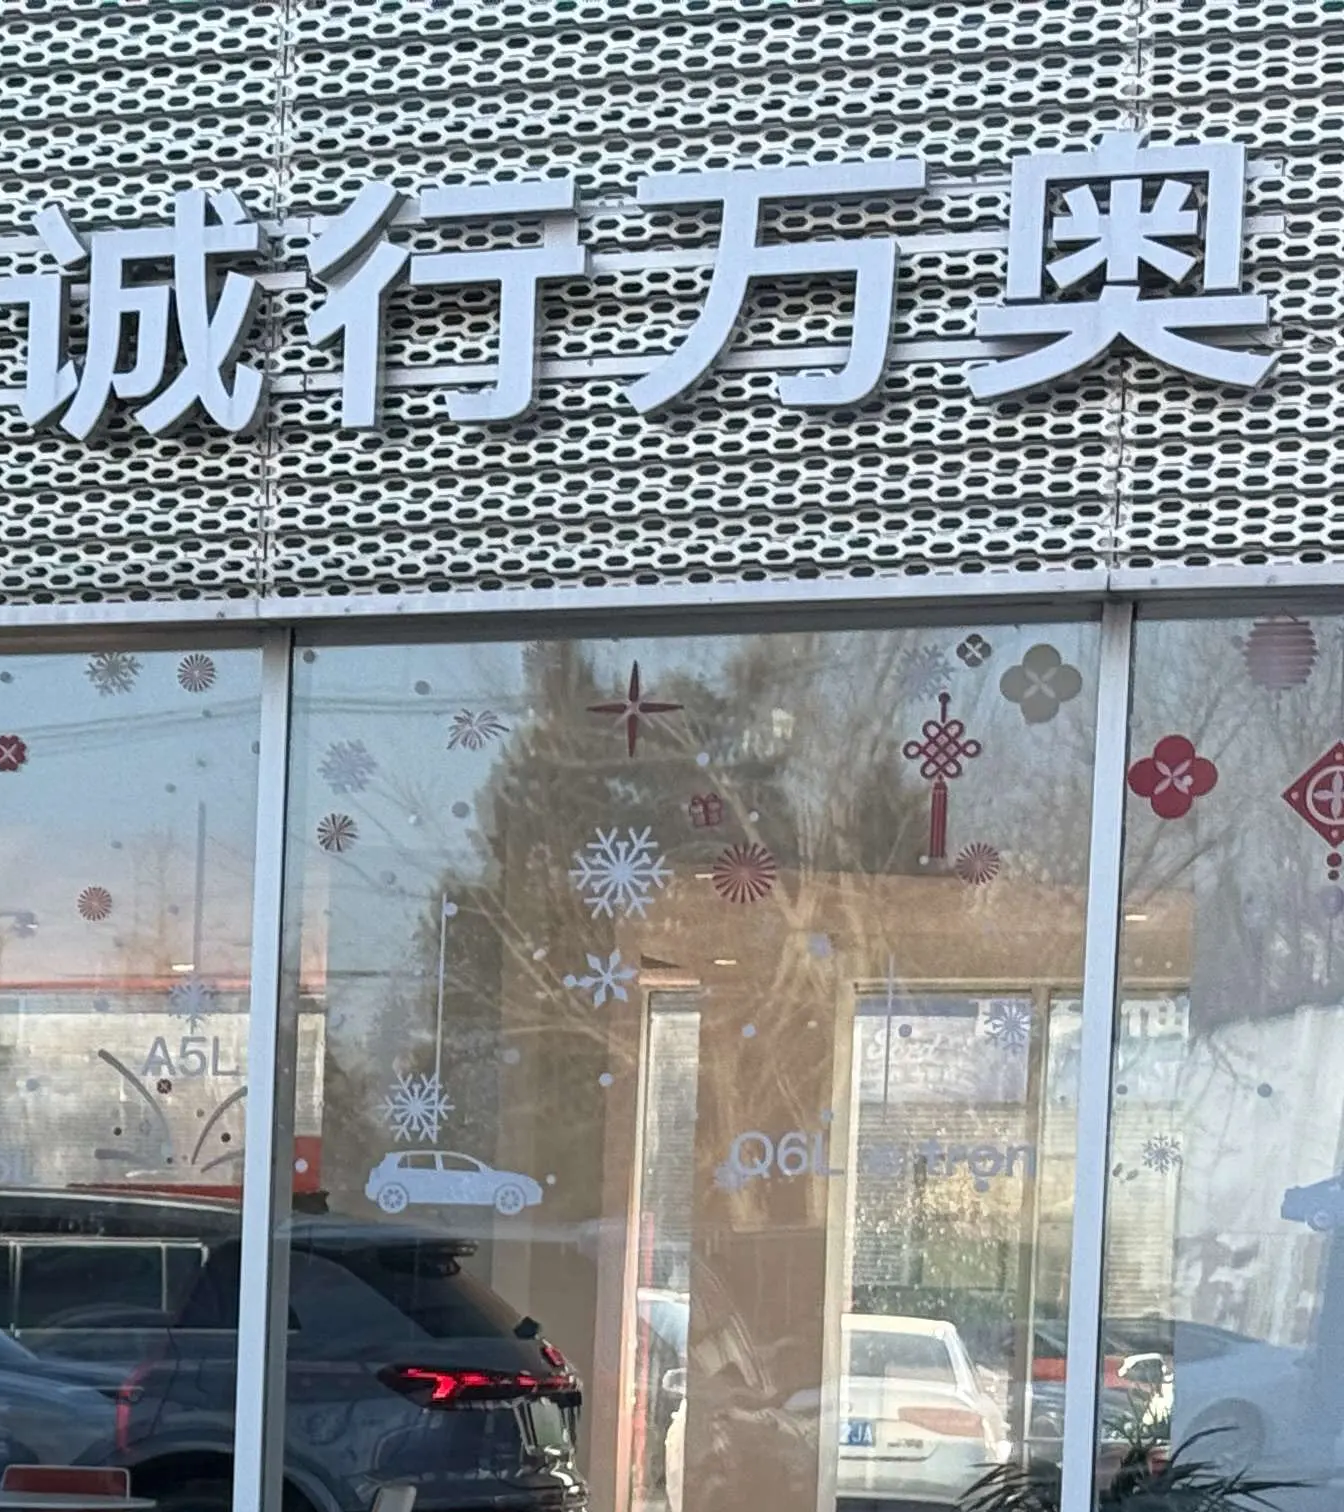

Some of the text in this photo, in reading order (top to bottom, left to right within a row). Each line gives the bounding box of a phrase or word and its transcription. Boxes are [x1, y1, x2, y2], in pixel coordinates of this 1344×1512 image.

[141, 1036, 239, 1077] A5L
[730, 1131, 1037, 1179] Q6L etron
